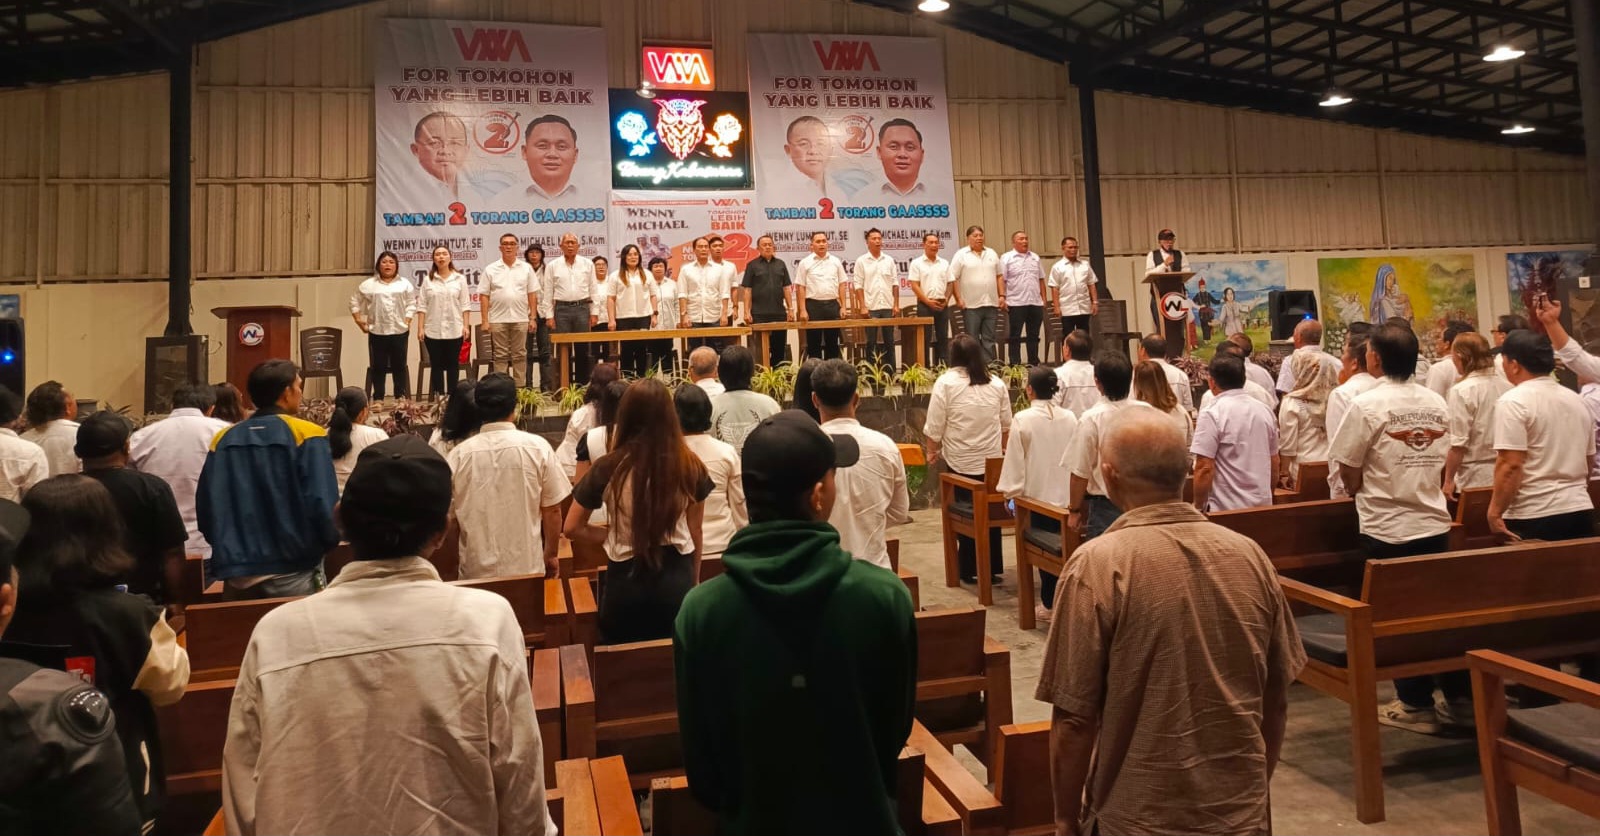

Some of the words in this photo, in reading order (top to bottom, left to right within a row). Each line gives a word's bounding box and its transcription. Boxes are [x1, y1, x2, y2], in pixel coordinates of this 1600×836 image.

[403, 68, 449, 82] FOR
[457, 69, 573, 85] TOMOHON
[774, 77, 812, 90] FOR
[820, 78, 917, 91] TOMOHON
[391, 87, 455, 102] YANG
[464, 88, 530, 103] LEBIH
[539, 90, 592, 104] BAIK
[765, 94, 818, 107] YANG
[826, 95, 880, 108] LEBIH
[888, 96, 933, 109] BAIK
[484, 122, 509, 148] 2
[383, 212, 445, 226] TAMBAH
[448, 201, 467, 225] 2
[471, 211, 529, 224] TORANG
[532, 207, 605, 223] GAASSSS
[626, 208, 675, 218] WENNY
[765, 207, 816, 219] TAMBAH
[818, 197, 834, 219] 2
[837, 206, 886, 219] TORANG
[888, 204, 949, 218] GAASSSS
[626, 220, 689, 231] MICHAEL
[711, 221, 746, 230] BAIK
[520, 236, 555, 247] MICHAEL
[581, 235, 605, 246] S.Kom
[839, 230, 849, 241] SE
[383, 239, 417, 250] WENNY
[471, 237, 482, 248] SE
[723, 233, 753, 260] 2
